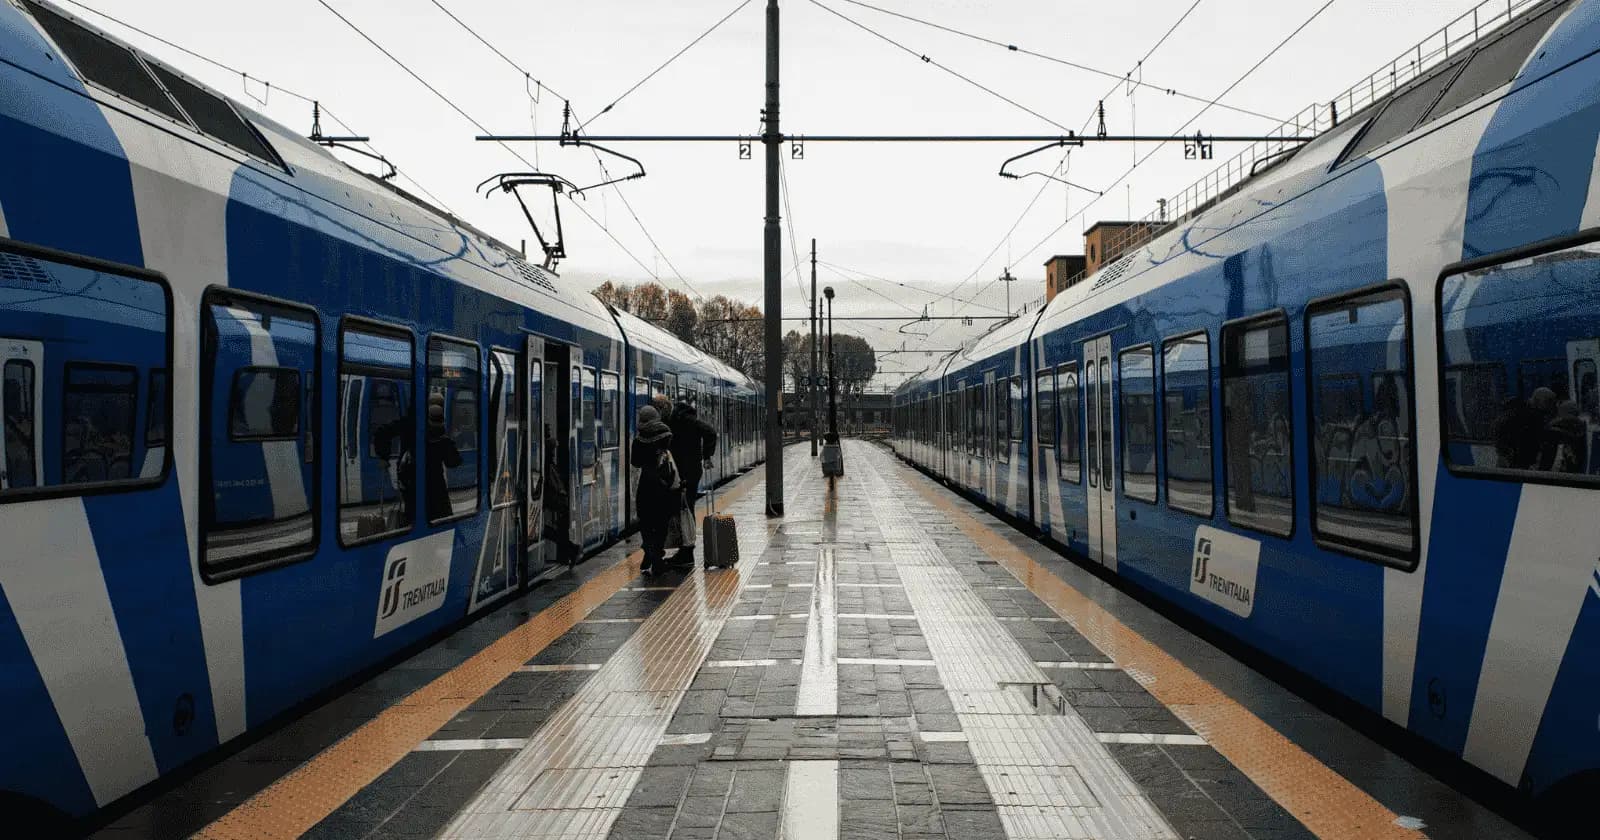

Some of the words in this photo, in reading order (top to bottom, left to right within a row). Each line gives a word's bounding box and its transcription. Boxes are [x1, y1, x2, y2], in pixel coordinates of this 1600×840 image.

[740, 145, 750, 159] 2
[792, 145, 803, 159] 2
[1185, 145, 1195, 158] 2
[402, 577, 445, 611] TRENITALIA
[1209, 573, 1250, 606] TRENITALIA
